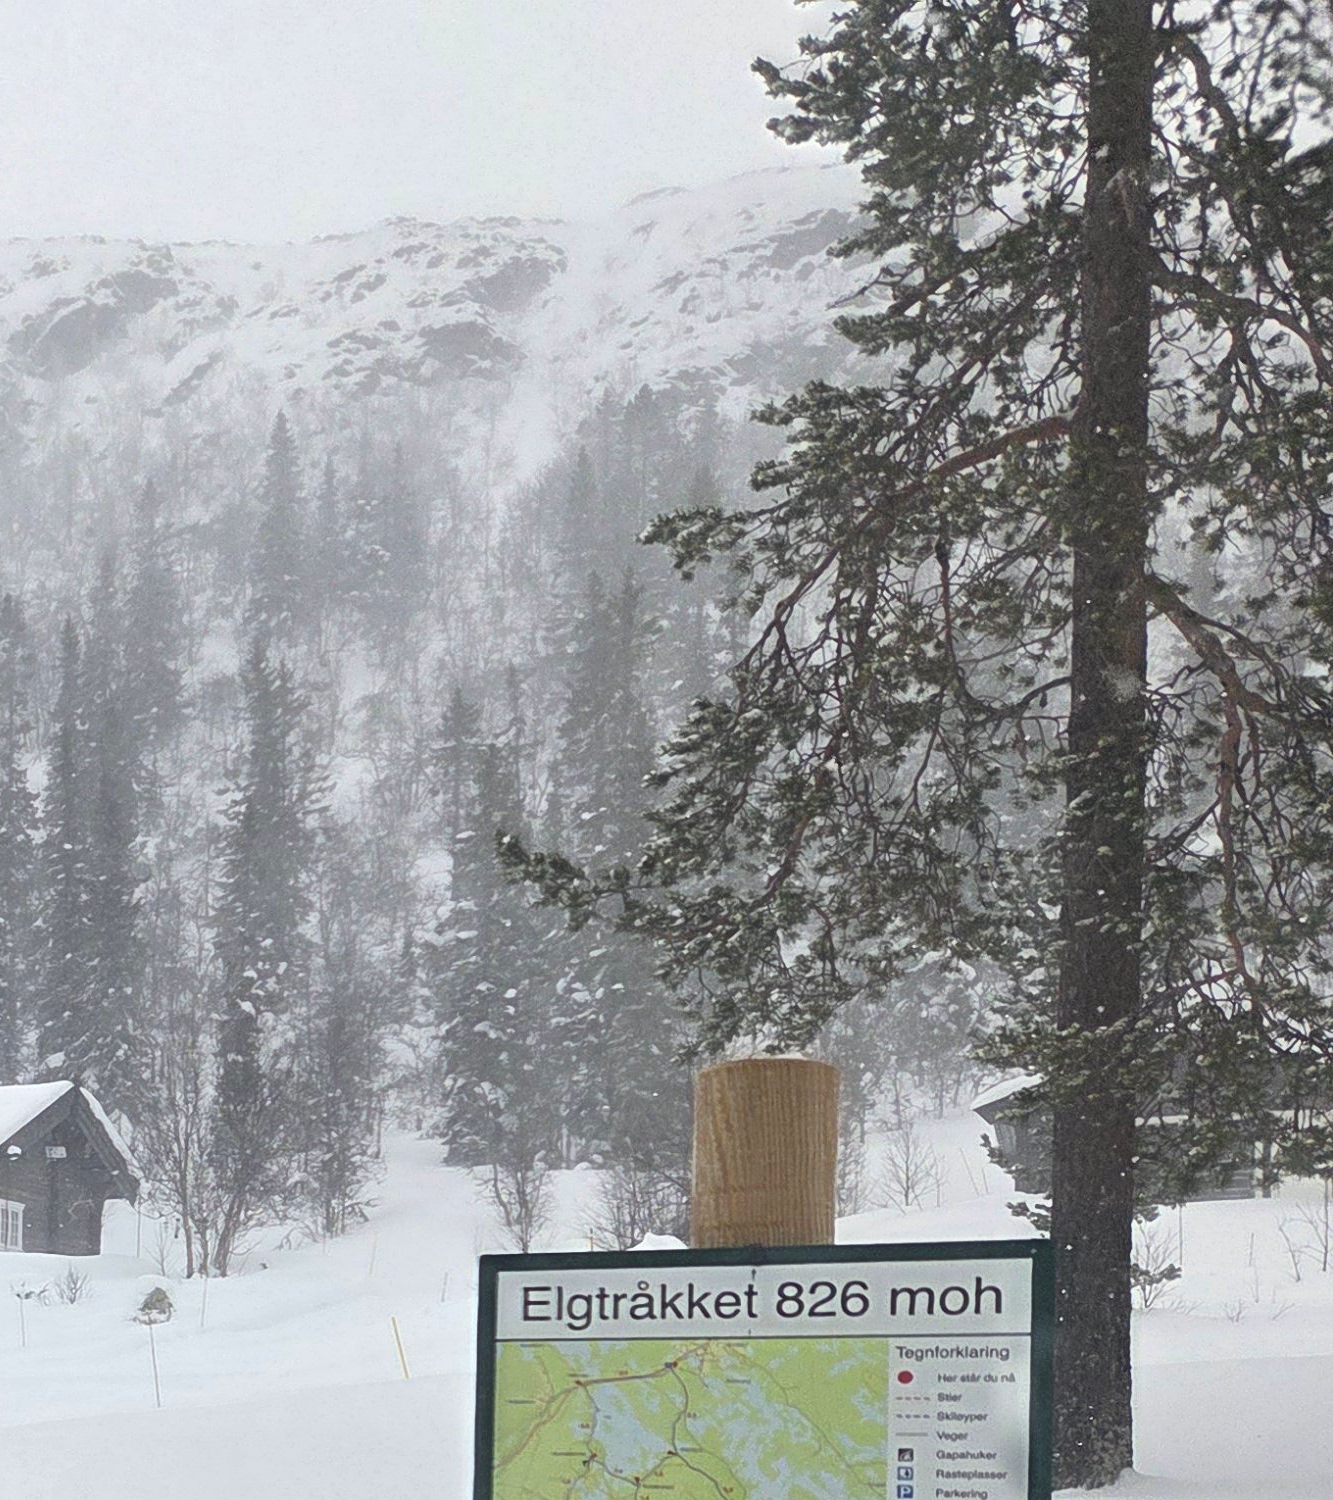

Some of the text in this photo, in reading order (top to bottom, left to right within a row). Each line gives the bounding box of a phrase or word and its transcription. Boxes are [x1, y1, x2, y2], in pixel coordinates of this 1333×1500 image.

[521, 1276, 1003, 1330] Elgtråkket 826 moh
[896, 1345, 1010, 1361] Tegnforklaring
[937, 1373, 958, 1383] Her
[983, 1373, 998, 1383] du
[1001, 1371, 1015, 1383] nå
[937, 1392, 962, 1403] Stier
[936, 1411, 988, 1424] Skiløyper
[936, 1431, 969, 1442] Veger
[936, 1450, 997, 1462] Gapahuker
[936, 1469, 1007, 1481] Rasteplasser
[935, 1488, 988, 1500] Parkering
